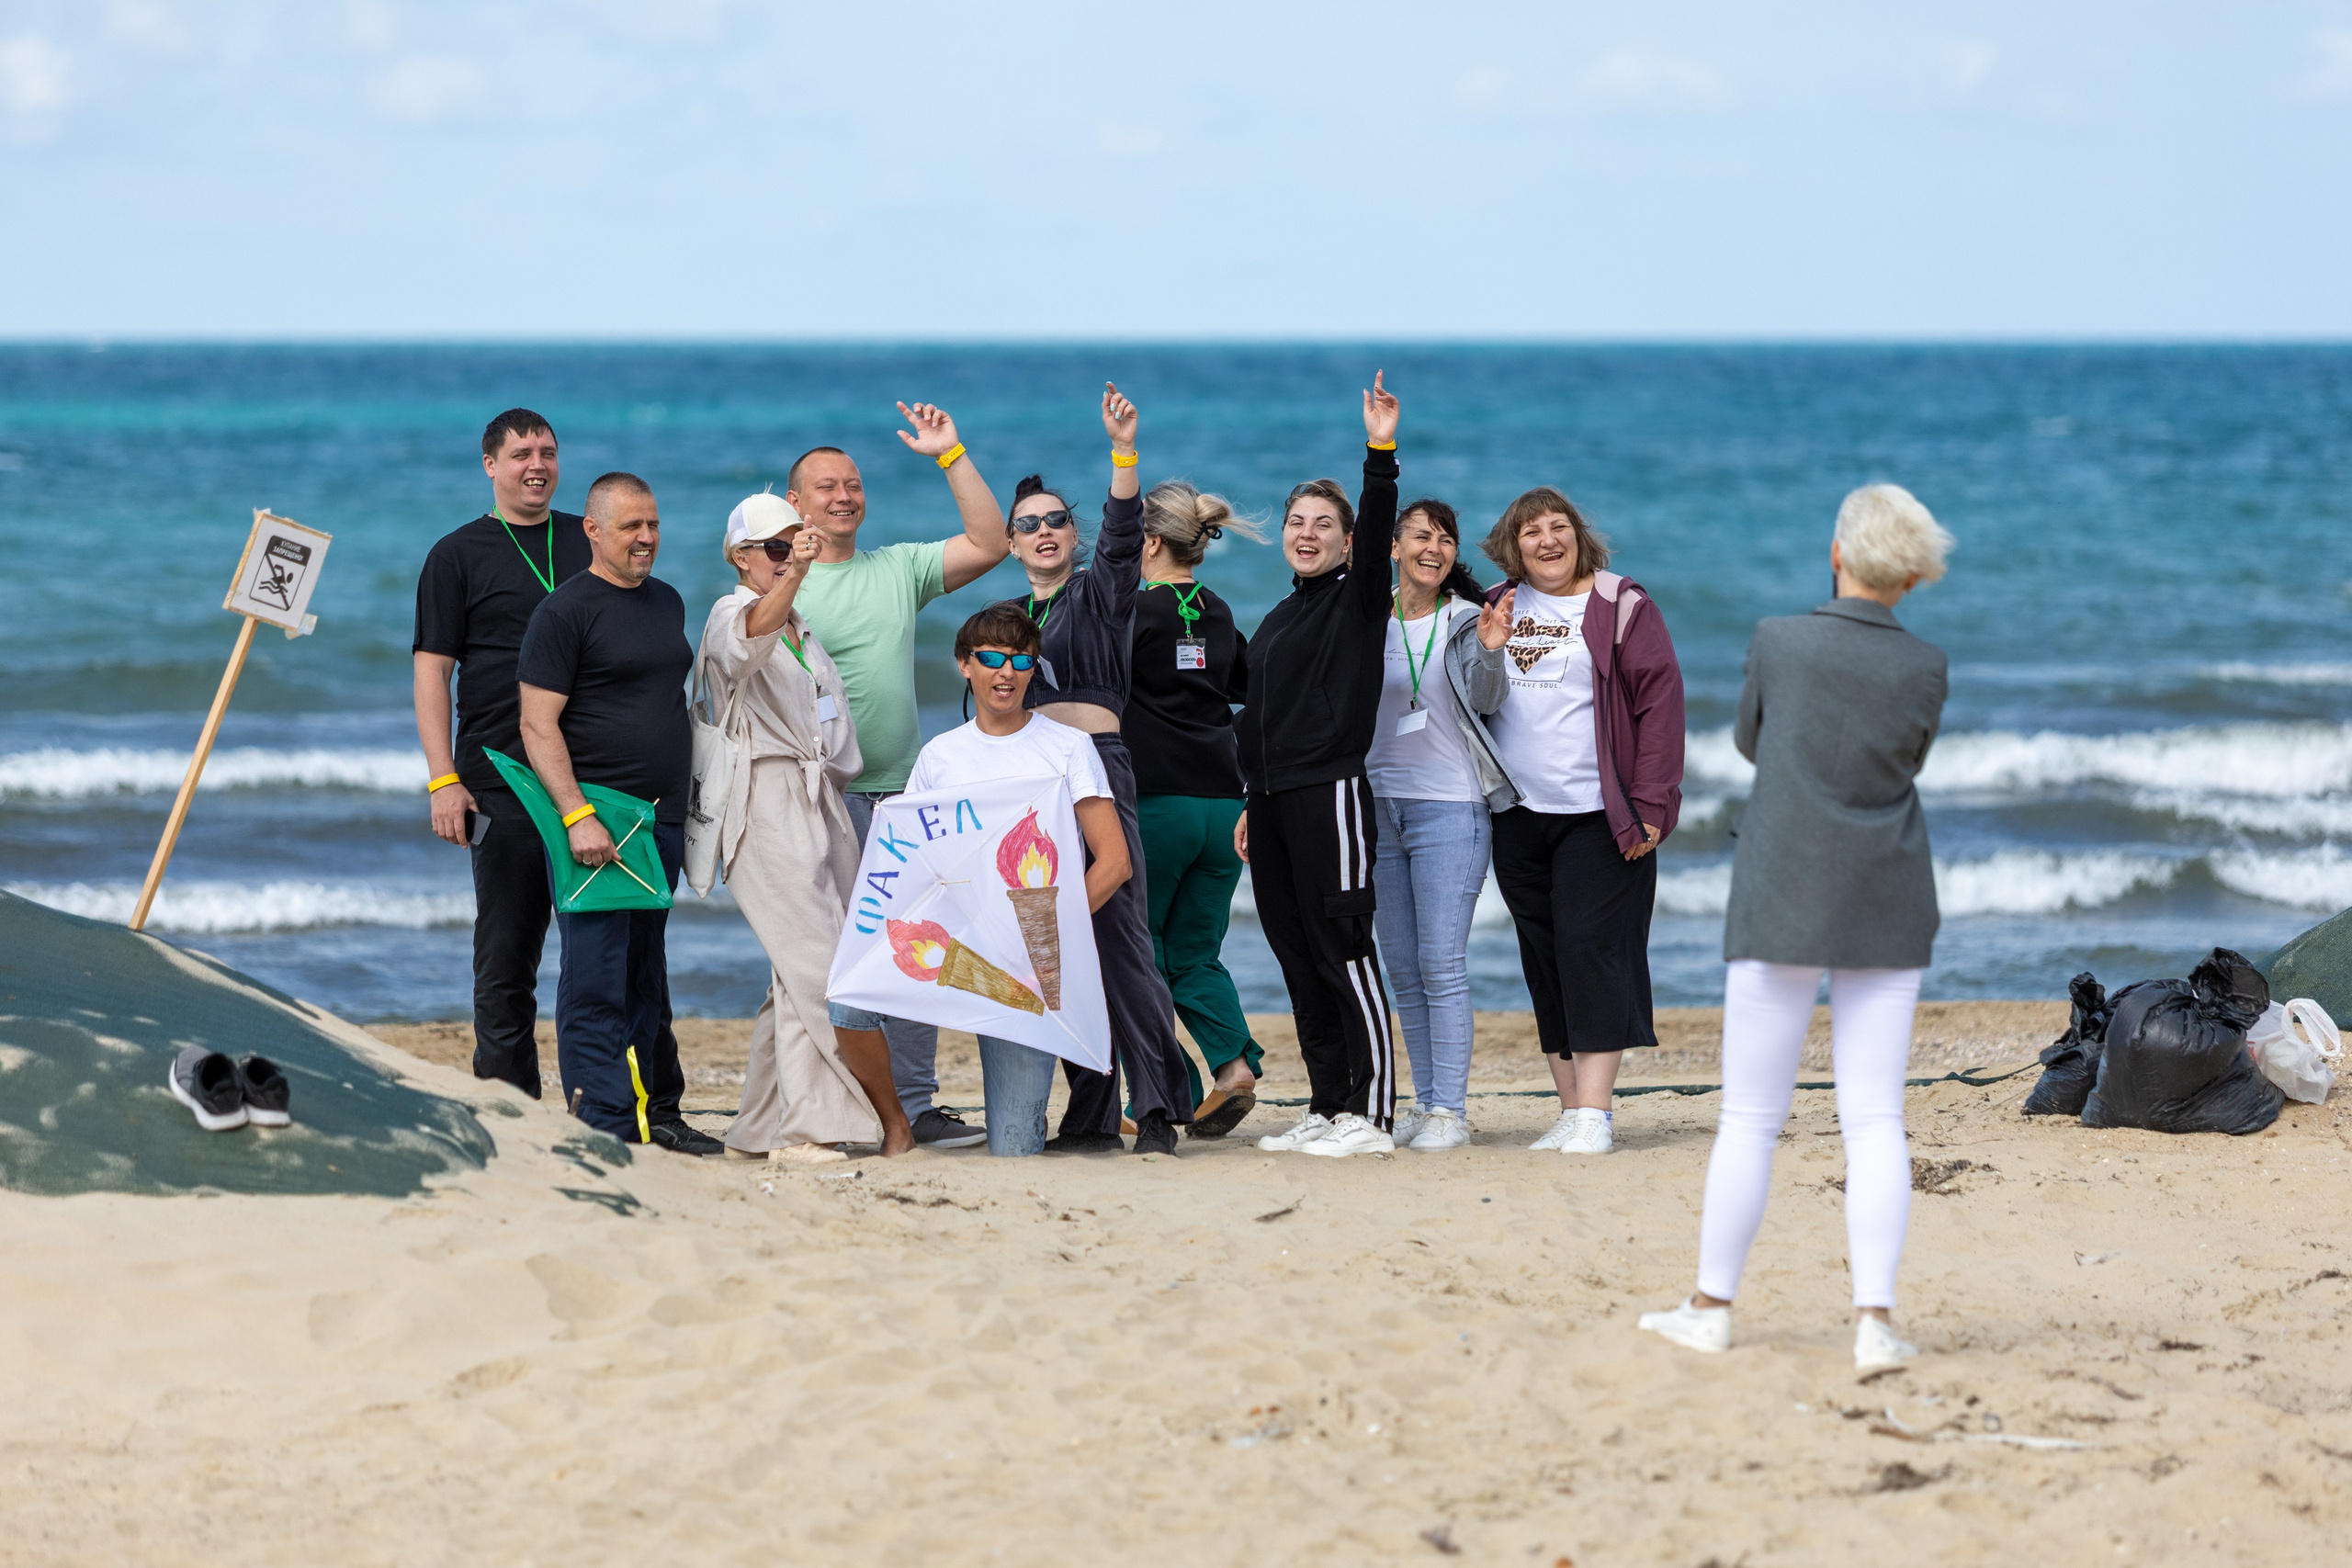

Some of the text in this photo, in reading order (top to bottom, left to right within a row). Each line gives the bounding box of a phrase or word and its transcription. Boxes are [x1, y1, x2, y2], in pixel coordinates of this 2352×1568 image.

[280, 540, 301, 552] КУПАНИЕ
[1510, 680, 1537, 689] BRAVE
[684, 831, 697, 846] УРГ
[854, 798, 983, 935] ФАКЕЛ
